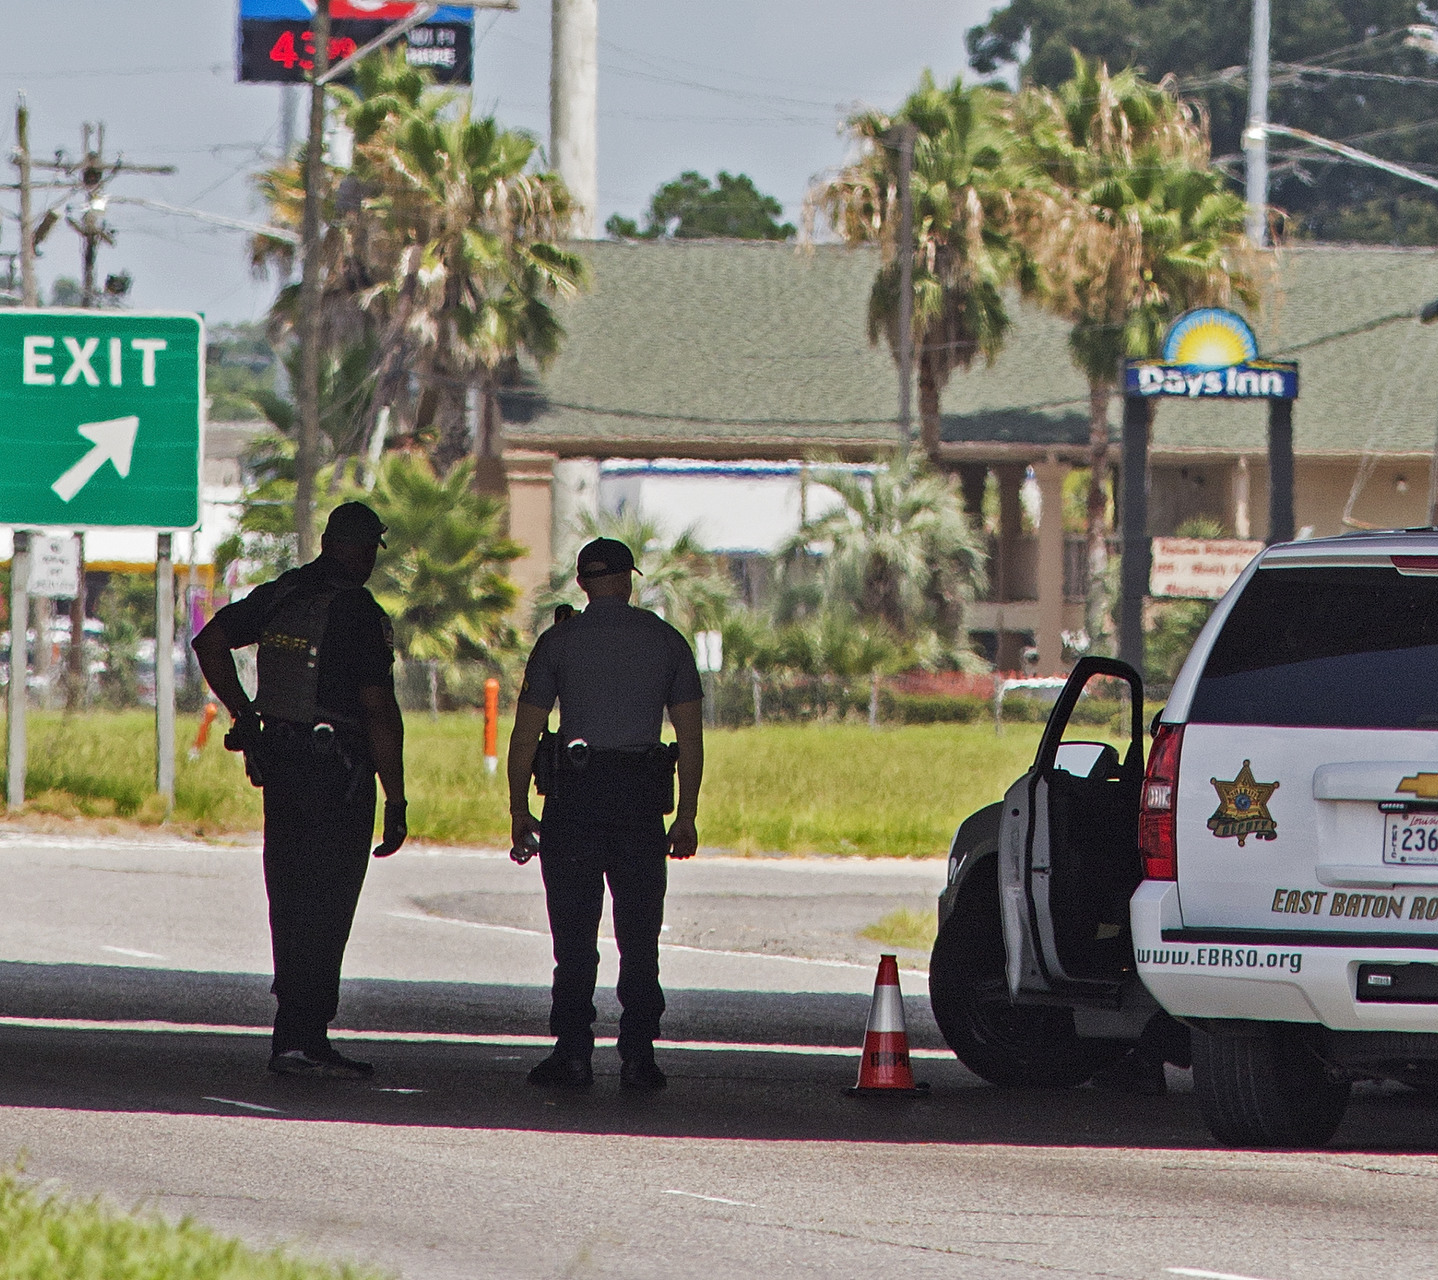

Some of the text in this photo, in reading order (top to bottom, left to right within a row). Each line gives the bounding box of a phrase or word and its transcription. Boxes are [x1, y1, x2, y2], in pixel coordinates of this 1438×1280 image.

[23, 335, 168, 388] EXIT
[1138, 365, 1285, 399] Days Inn
[1271, 889, 1328, 915] EAST
[1329, 891, 1406, 919] BATON
[1137, 948, 1303, 974] www.EBRSO.org
